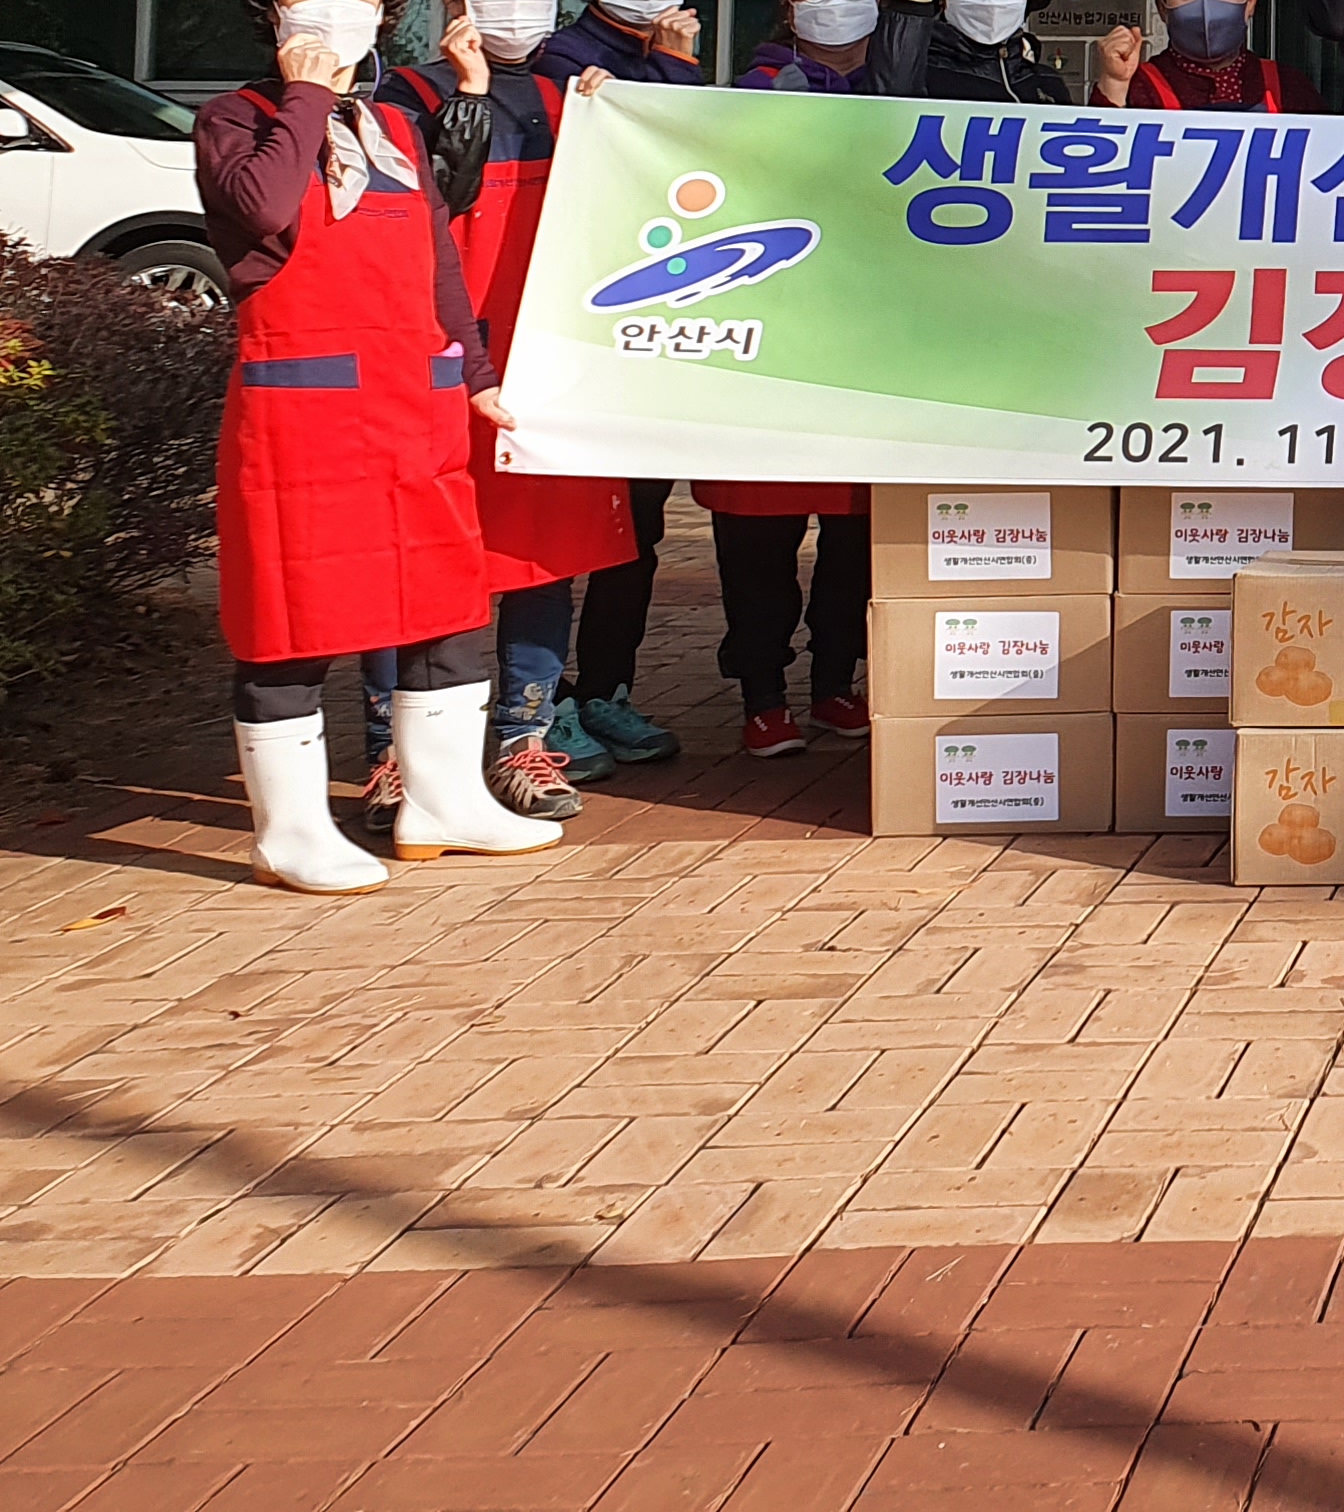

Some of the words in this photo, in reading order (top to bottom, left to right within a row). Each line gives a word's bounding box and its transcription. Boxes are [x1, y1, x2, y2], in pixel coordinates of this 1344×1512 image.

[619, 320, 760, 357] 안산시
[1083, 422, 1245, 467] 2021.
[932, 529, 986, 544] 이웃사랑
[994, 528, 1048, 543] 김장나눔
[1175, 528, 1229, 543] 이웃사랑
[1237, 528, 1290, 543] 김장나눔
[1261, 601, 1333, 643] 감자
[945, 641, 990, 655] 이웃사랑
[998, 640, 1050, 655] 김장나눔
[1180, 640, 1225, 654] 이웃사랑
[940, 770, 994, 786] 이웃사랑
[1001, 769, 1055, 785] 김장나눔
[1170, 765, 1223, 780] 이웃사랑
[1265, 758, 1337, 801] 감자
